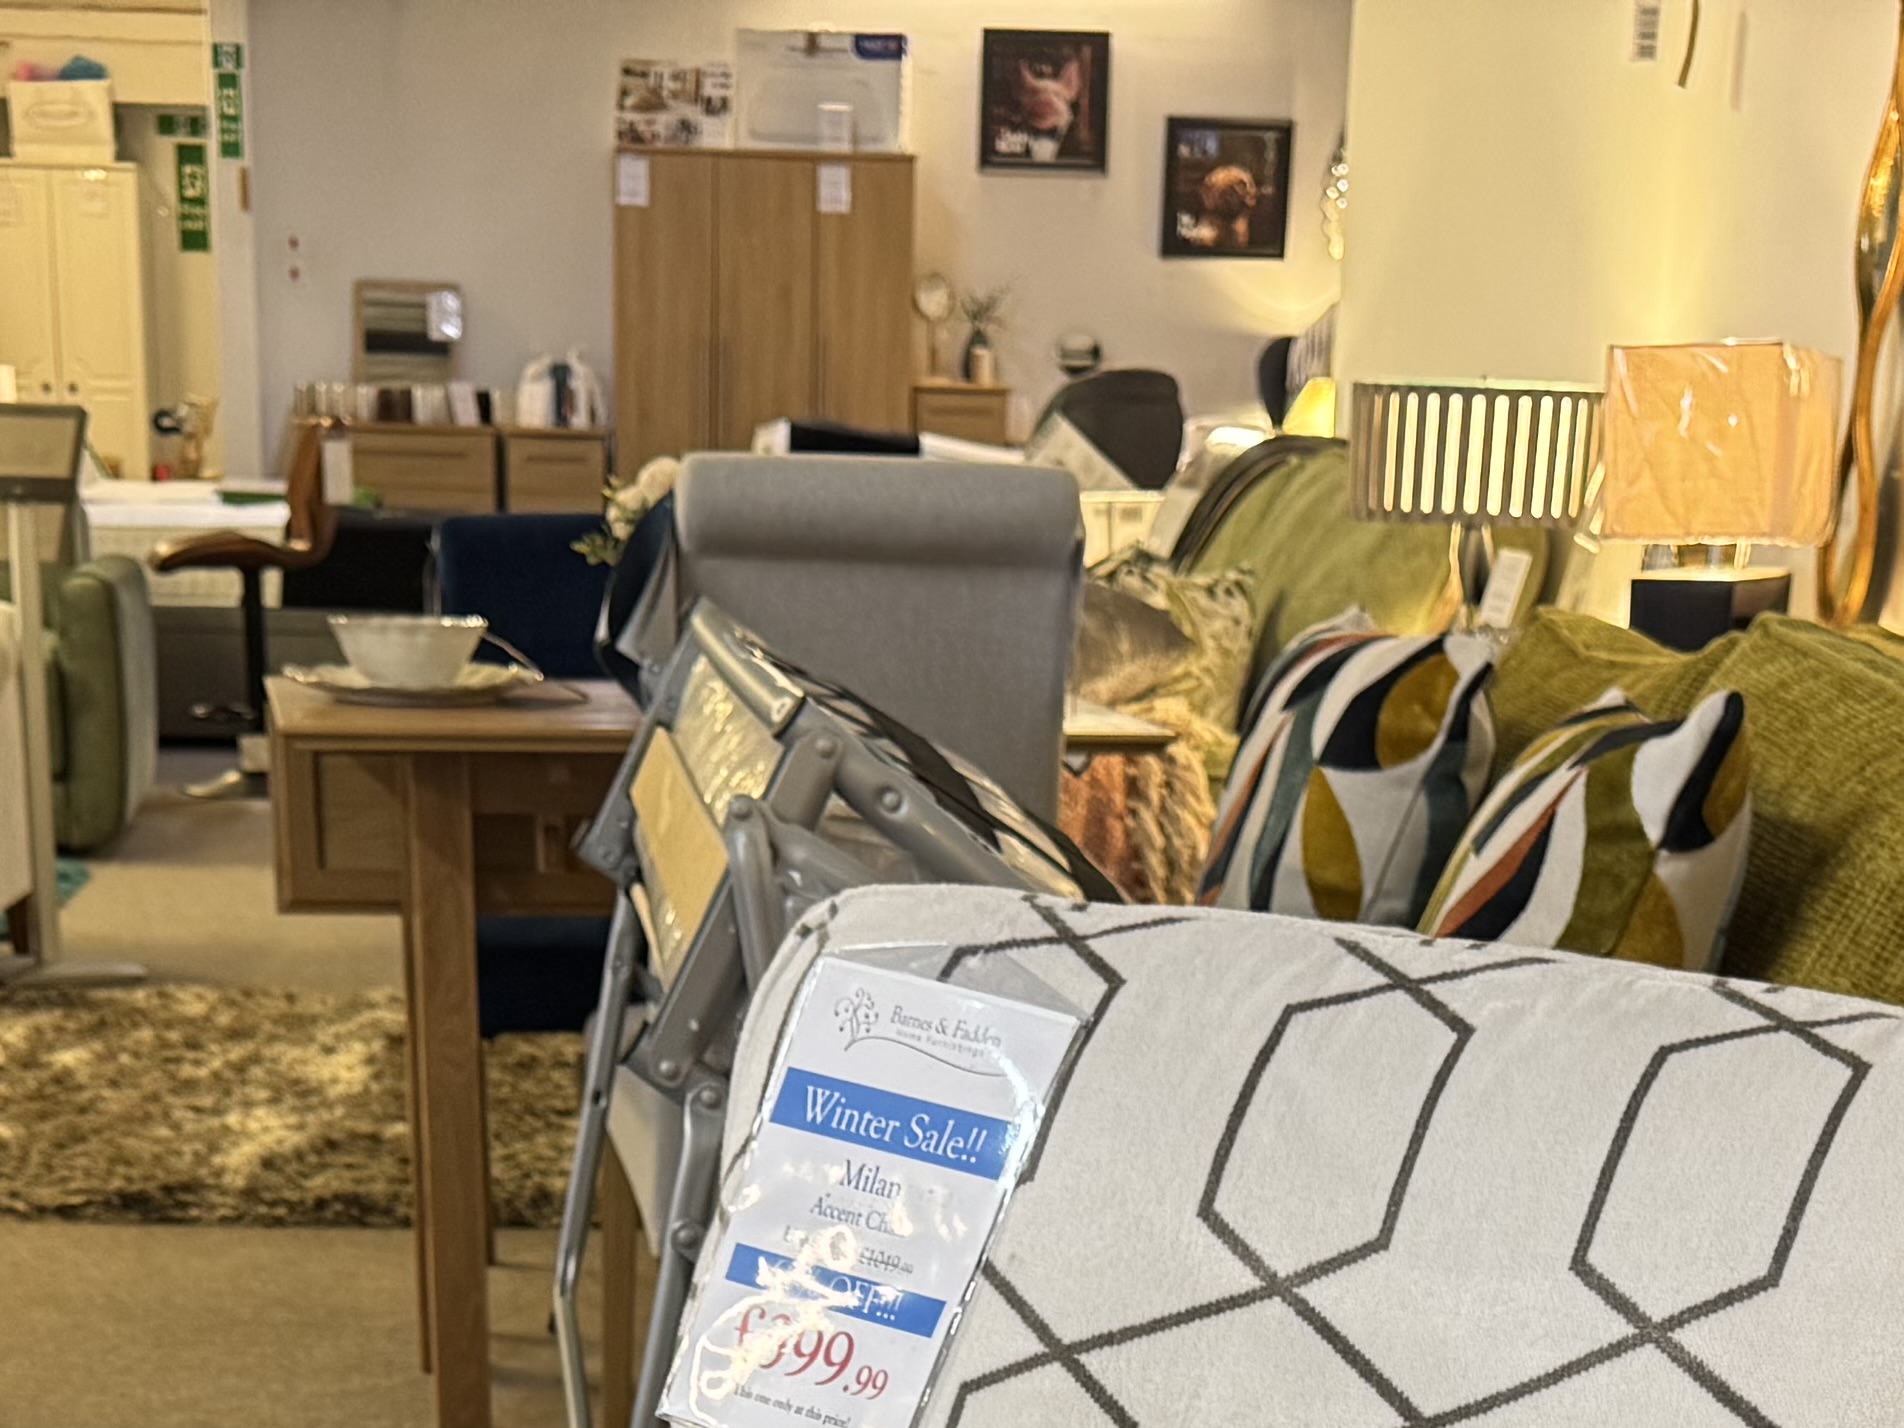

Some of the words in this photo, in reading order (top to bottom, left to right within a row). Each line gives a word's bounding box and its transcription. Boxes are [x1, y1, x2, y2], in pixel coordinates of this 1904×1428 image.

[934, 1017, 950, 1036] &
[806, 1085, 900, 1142] Winter
[904, 1113, 988, 1164] Sale!!
[838, 1158, 901, 1199] Milan
[809, 1196, 863, 1225] Accent
